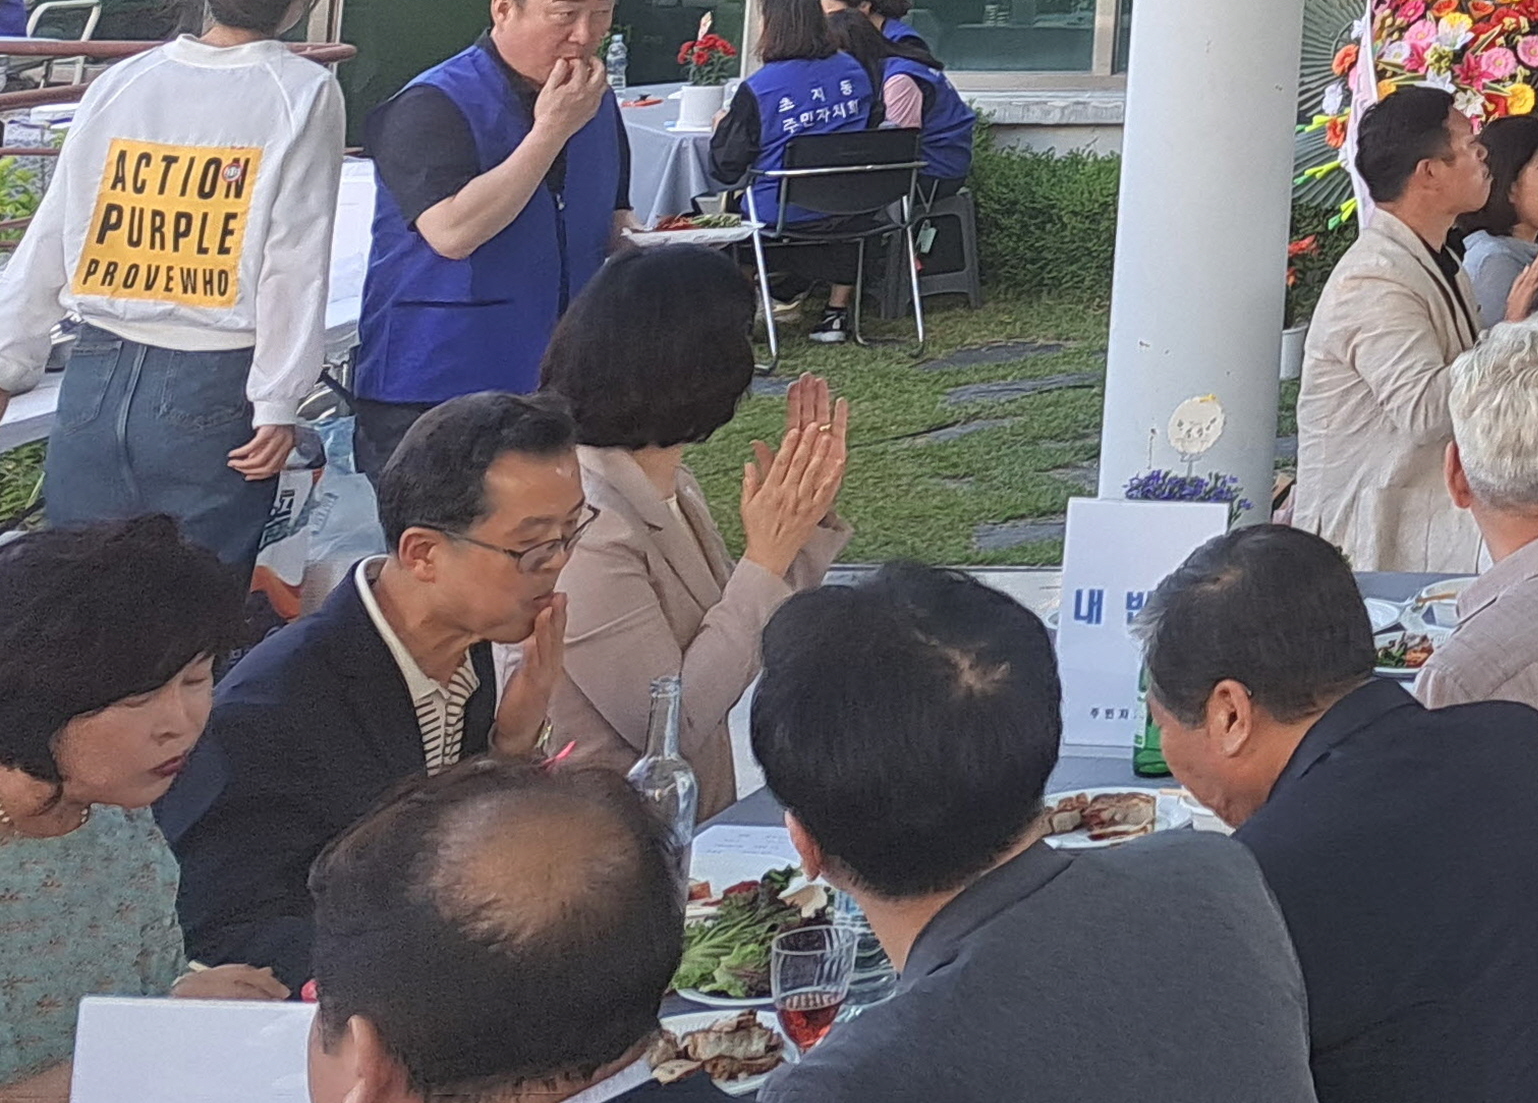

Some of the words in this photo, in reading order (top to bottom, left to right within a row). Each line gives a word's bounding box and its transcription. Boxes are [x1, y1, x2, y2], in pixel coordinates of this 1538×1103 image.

[782, 99, 860, 133] 주민자치회
[110, 149, 251, 200] ACTION
[95, 203, 239, 256] PURPLE
[82, 258, 229, 297] PROVEWHO
